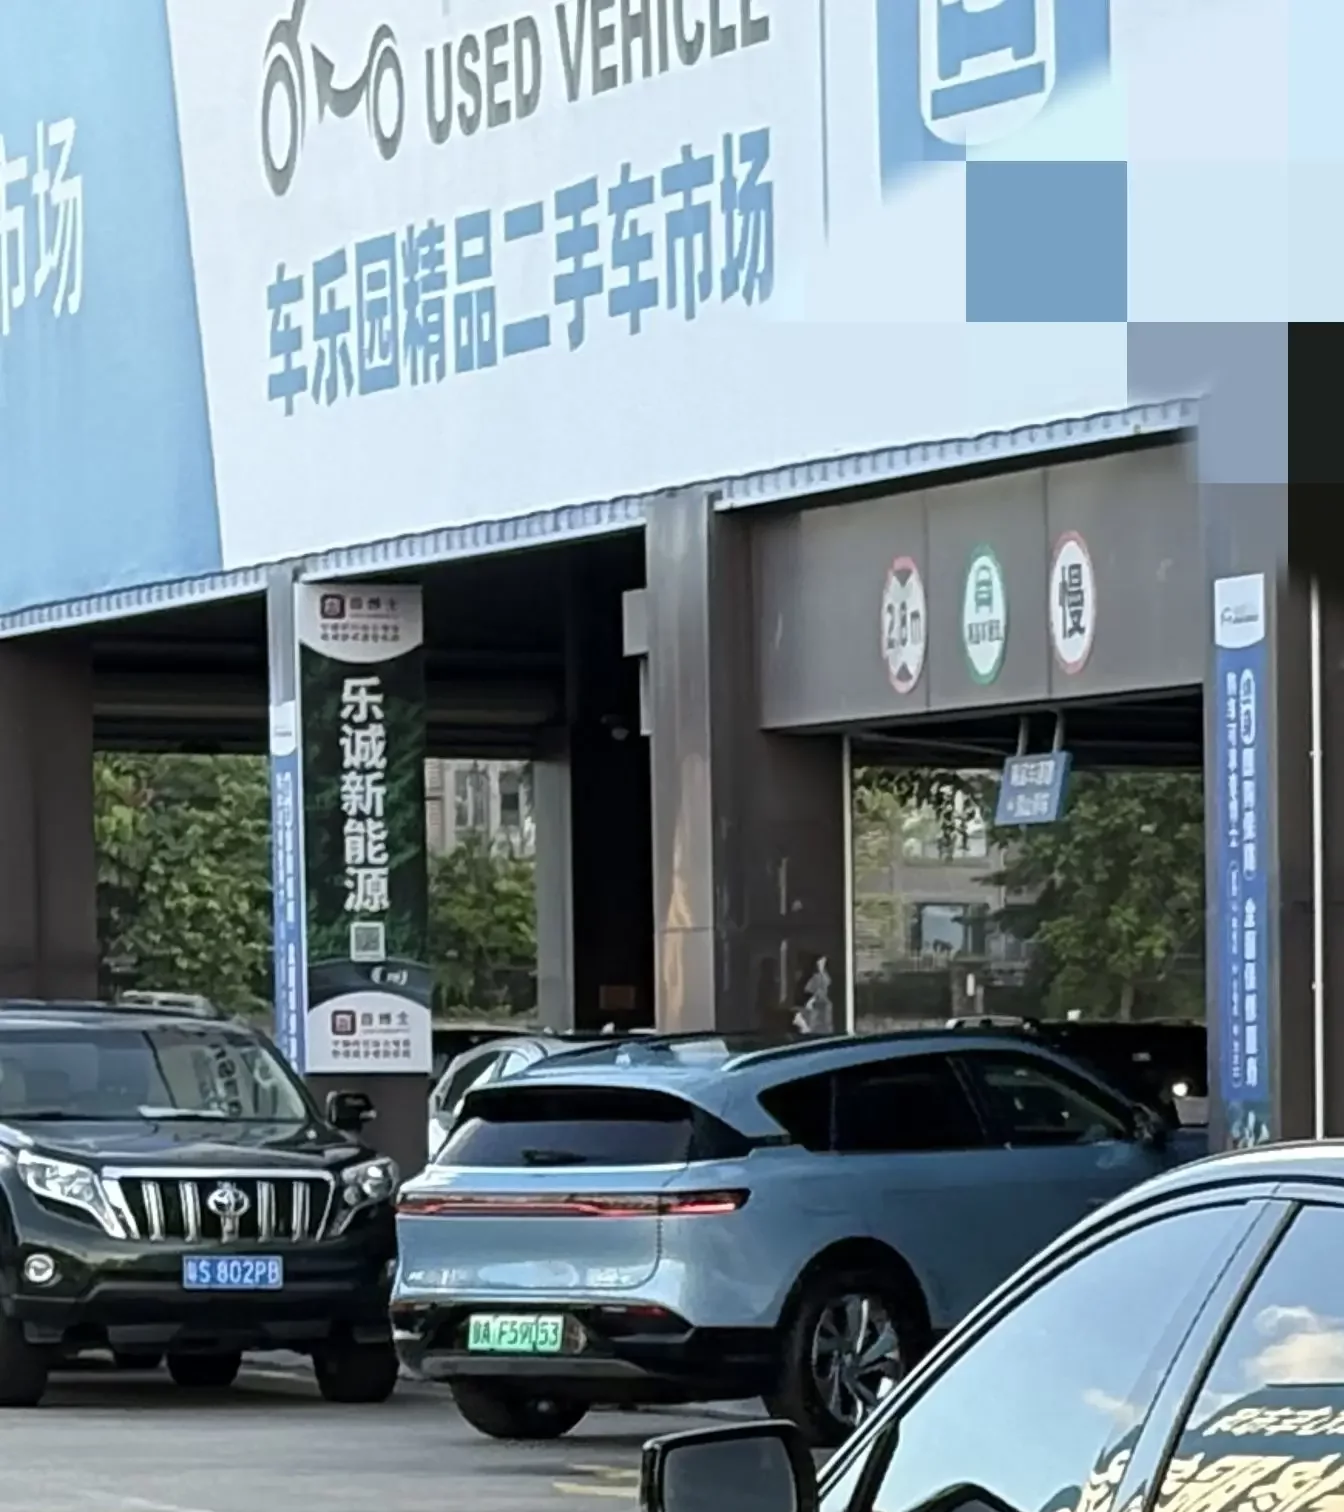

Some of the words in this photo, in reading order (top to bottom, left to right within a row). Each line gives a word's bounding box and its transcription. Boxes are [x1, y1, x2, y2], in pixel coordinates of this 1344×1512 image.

[425, 14, 542, 145] USED
[267, 127, 776, 416] 车乐园精品二手车市场
[1058, 563, 1086, 640] 慢
[339, 676, 391, 913] 乐诚新能源
